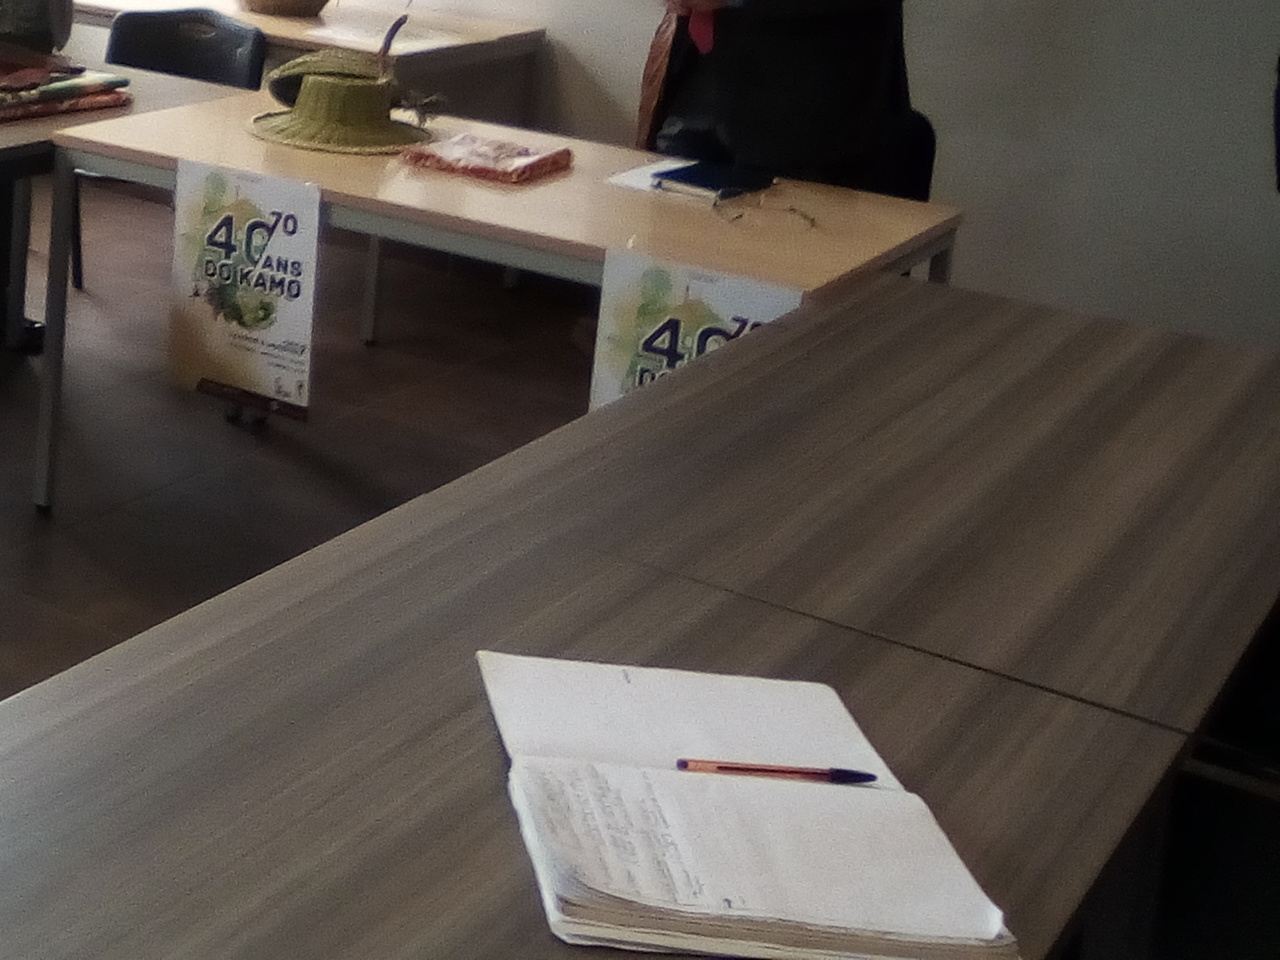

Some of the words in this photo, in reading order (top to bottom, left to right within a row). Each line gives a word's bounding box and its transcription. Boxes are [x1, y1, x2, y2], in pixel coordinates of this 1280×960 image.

[205, 214, 272, 266] 40
[269, 210, 299, 236] 70
[204, 259, 232, 282] DO
[239, 267, 302, 300] KAMO
[260, 255, 303, 278] ANS
